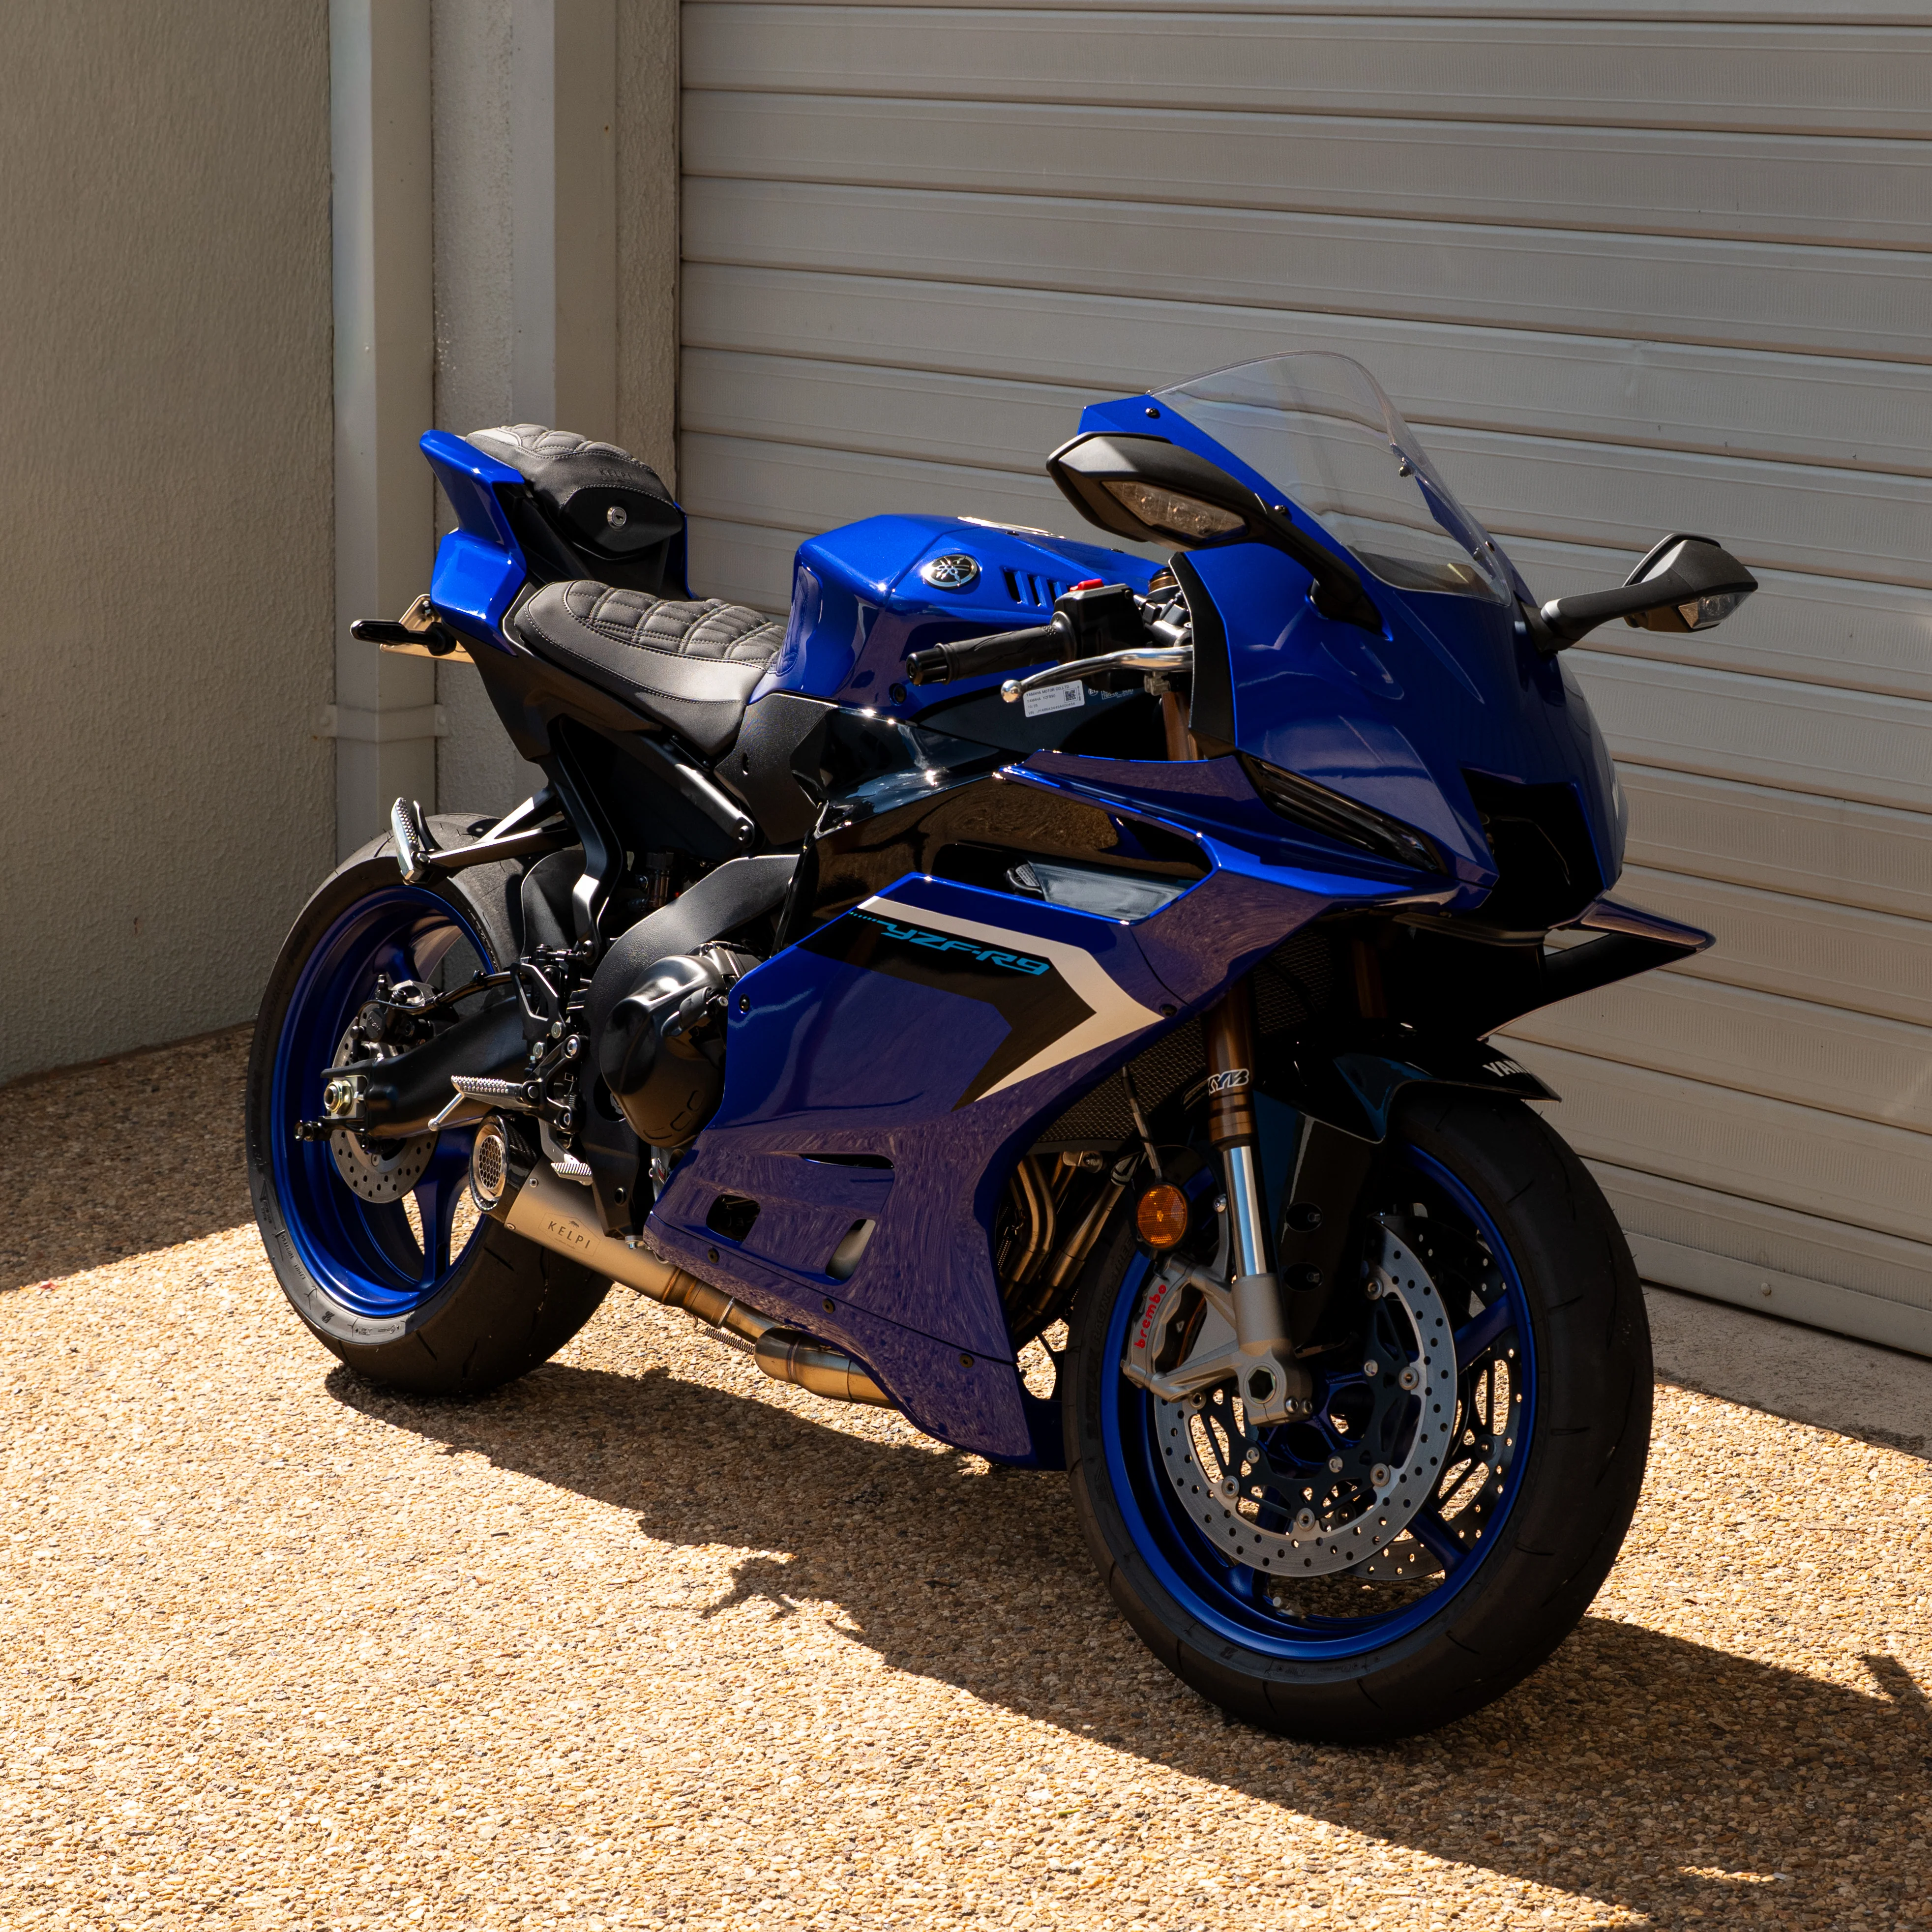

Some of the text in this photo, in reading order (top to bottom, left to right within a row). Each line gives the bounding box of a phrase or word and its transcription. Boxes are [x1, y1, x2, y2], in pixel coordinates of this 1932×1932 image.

[598, 469, 632, 480] KELPI
[876, 920, 1050, 976] YZF-R9
[547, 1220, 591, 1249] KELPI
[1135, 1284, 1166, 1349] brembo
